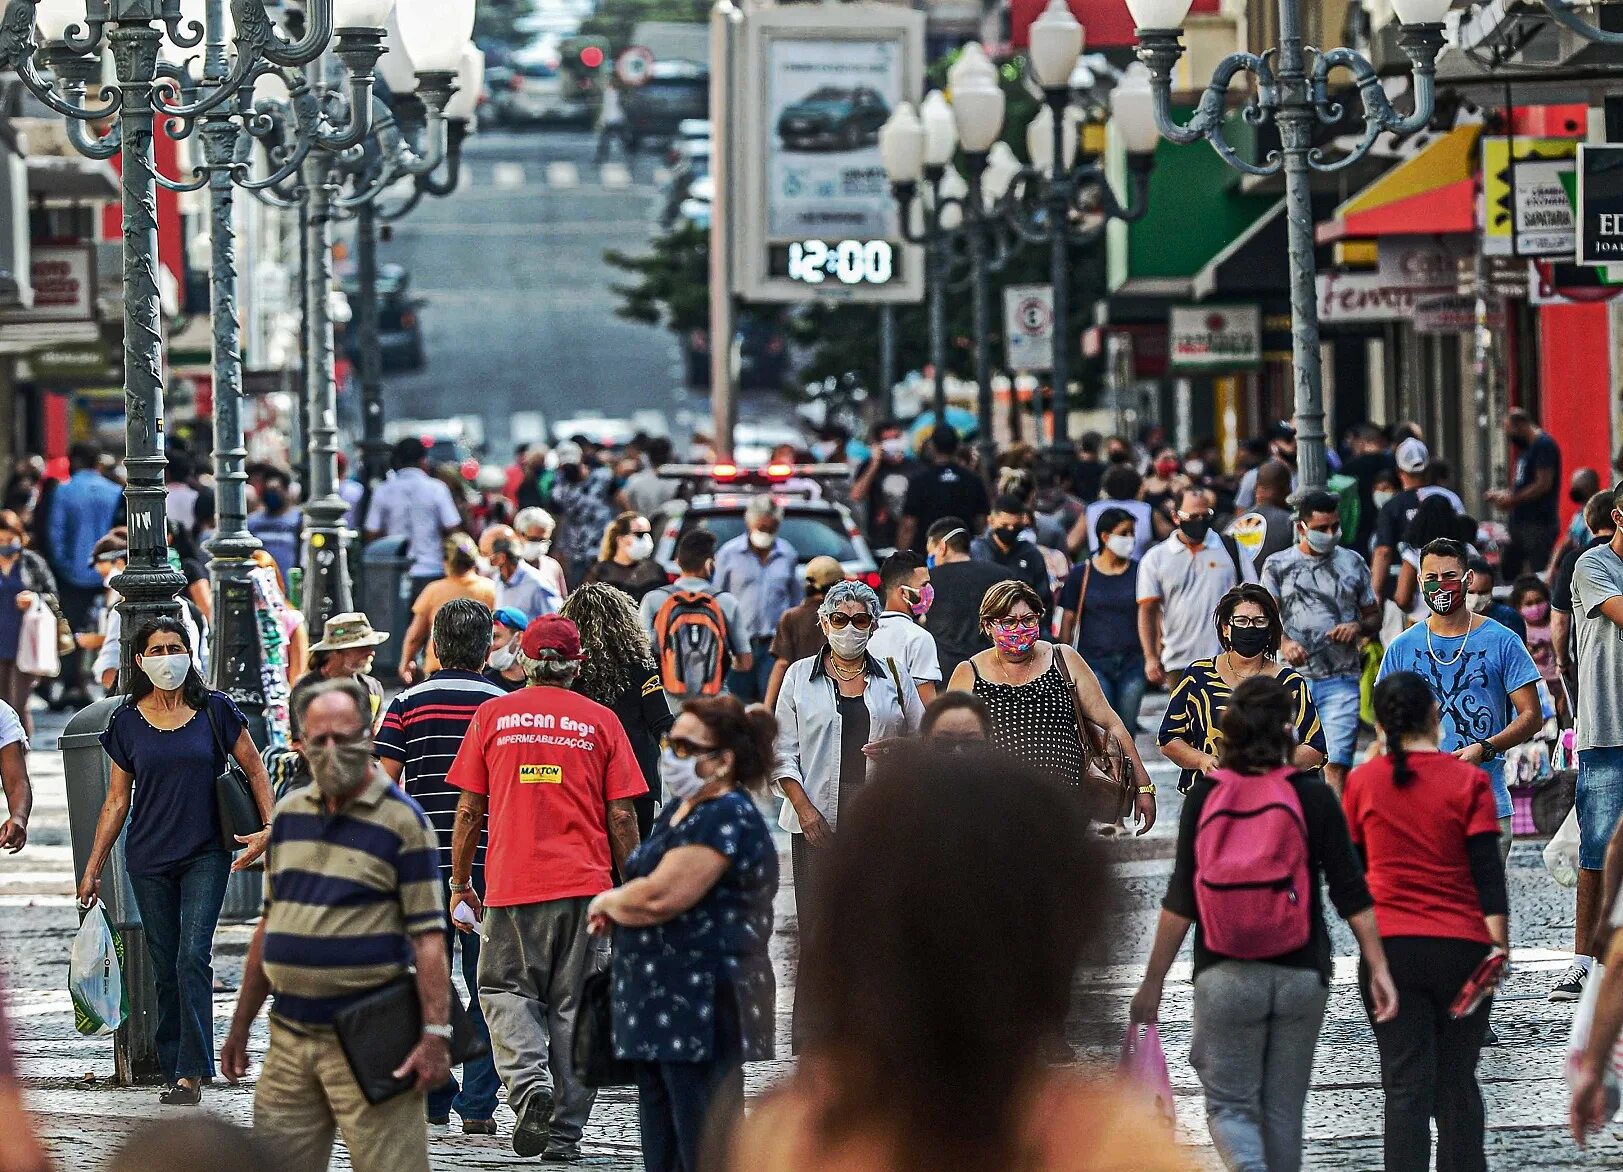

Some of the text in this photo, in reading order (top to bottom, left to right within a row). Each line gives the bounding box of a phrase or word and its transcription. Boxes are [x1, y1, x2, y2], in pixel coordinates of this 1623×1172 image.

[788, 240, 893, 284] 12:00
[497, 713, 556, 731] MACAN
[521, 766, 560, 776] MAXTON
